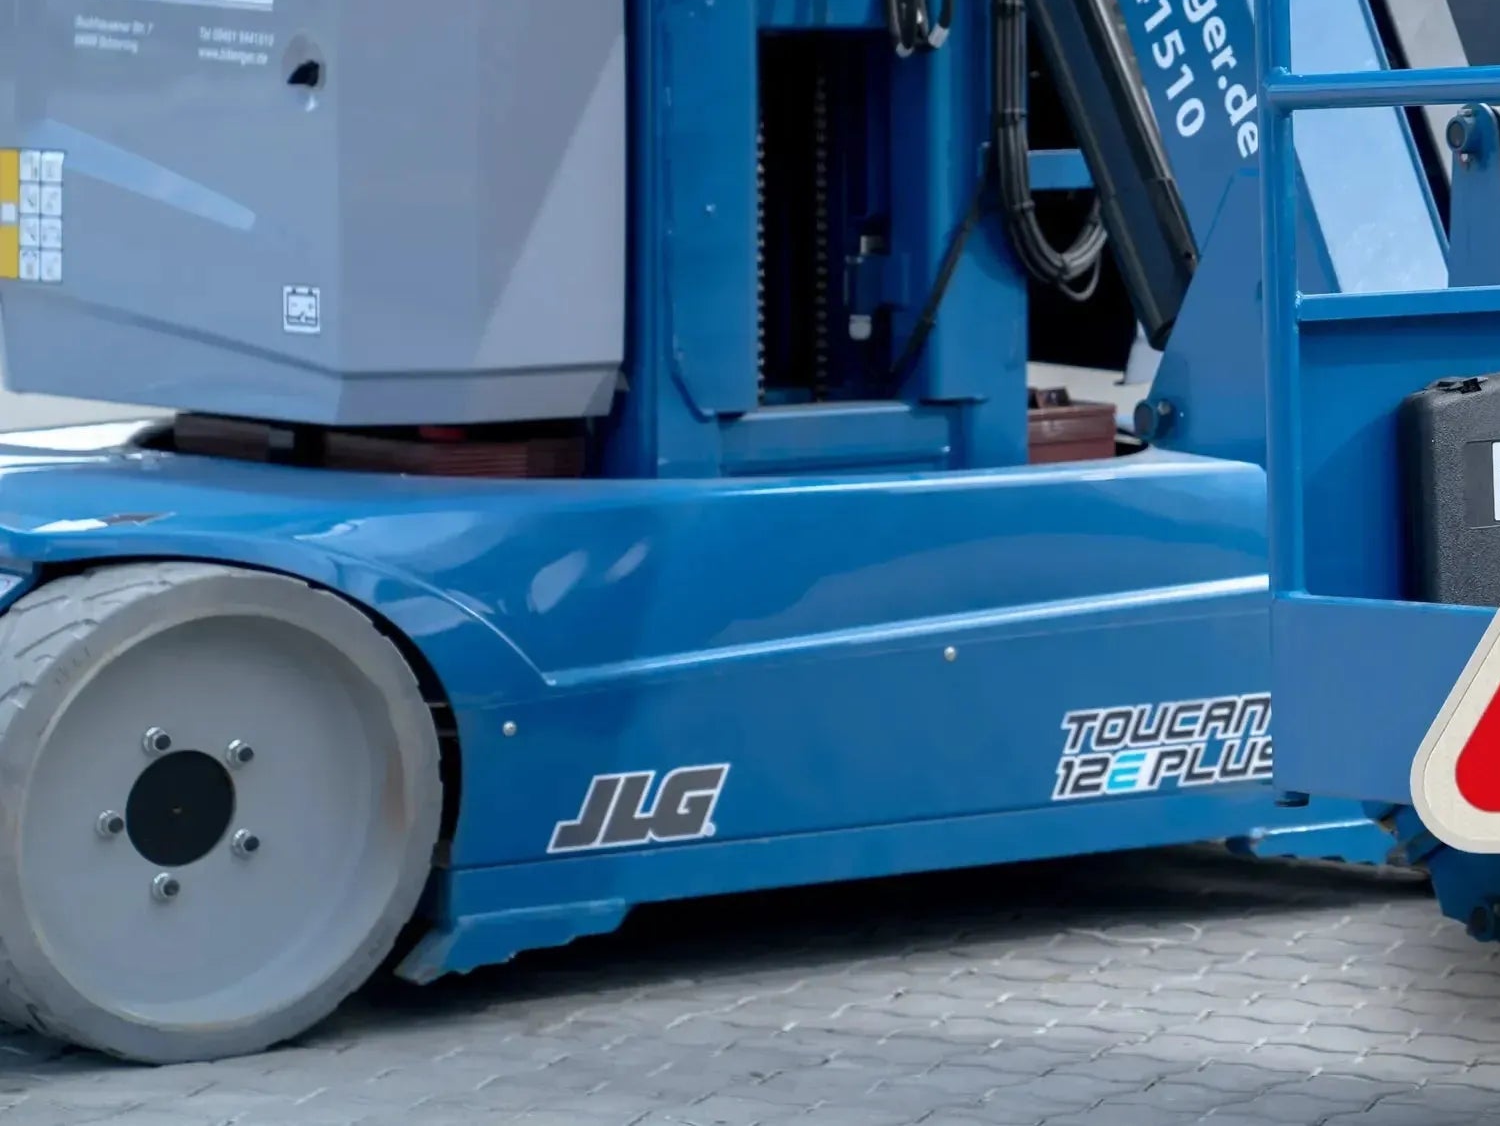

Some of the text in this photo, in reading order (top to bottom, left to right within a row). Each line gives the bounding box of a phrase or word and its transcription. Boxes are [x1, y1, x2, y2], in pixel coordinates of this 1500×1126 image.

[1062, 693, 1271, 754] TOUCAN
[1052, 751, 1148, 800] 12E
[547, 763, 730, 853] JLG
